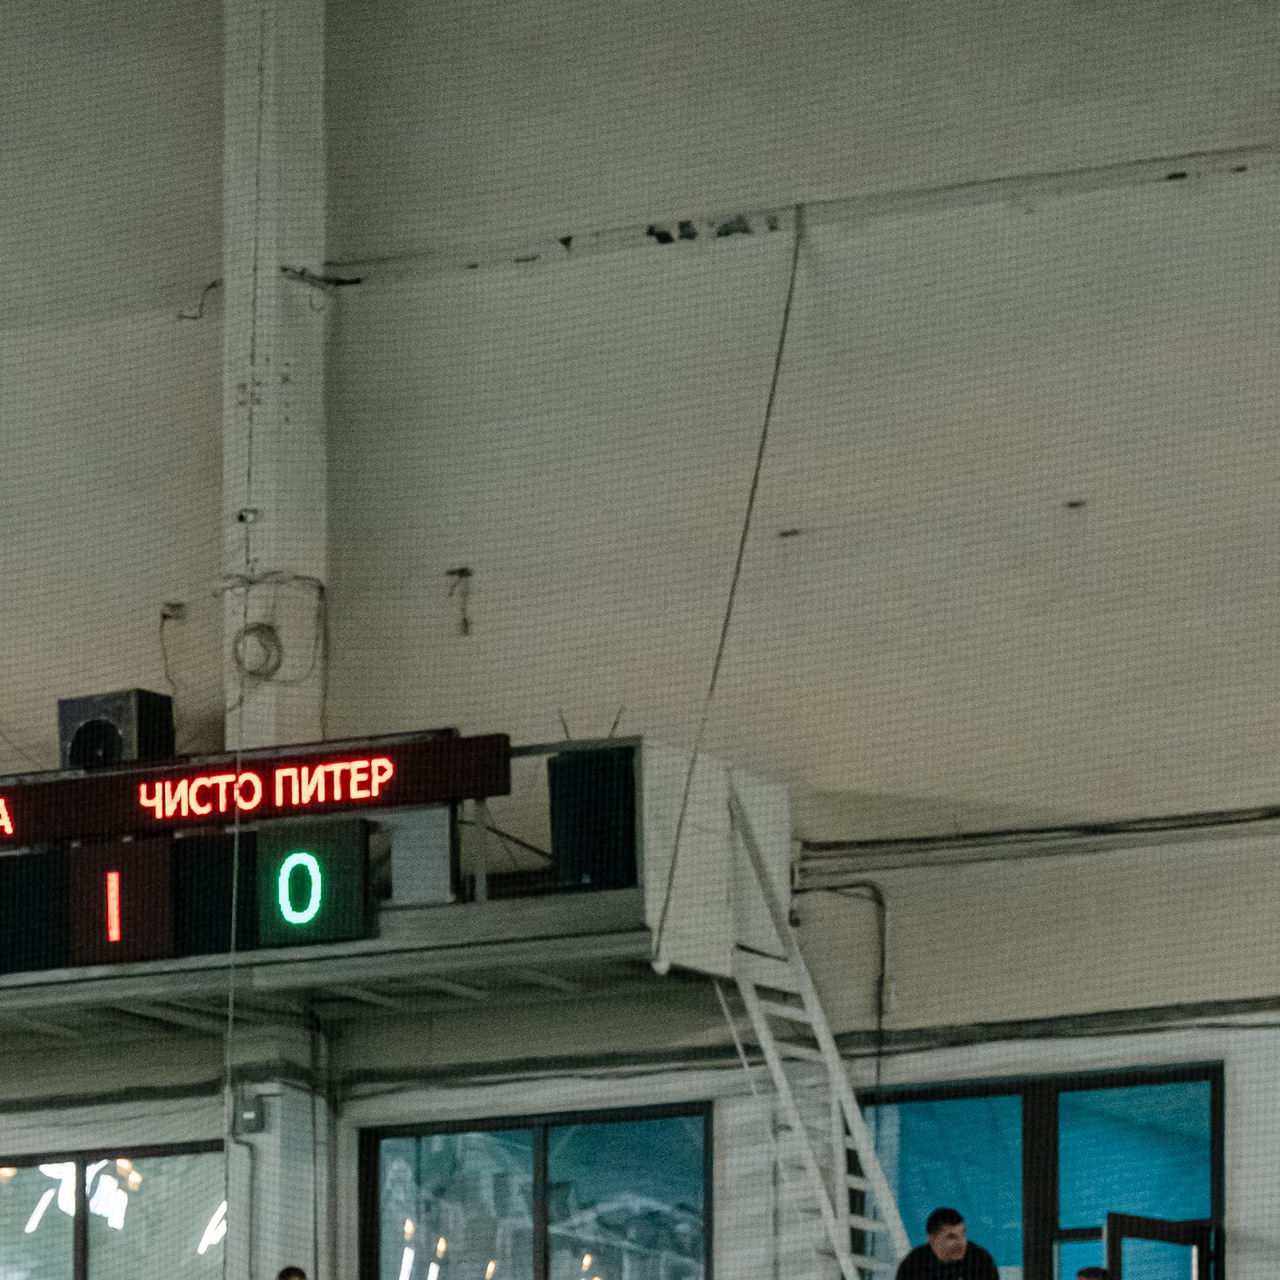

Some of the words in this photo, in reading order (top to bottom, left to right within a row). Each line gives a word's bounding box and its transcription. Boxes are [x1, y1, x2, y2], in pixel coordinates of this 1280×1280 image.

[139, 772, 262, 819] ЧИСТО
[275, 758, 393, 807] ПИТЕР
[278, 852, 321, 924] 0
